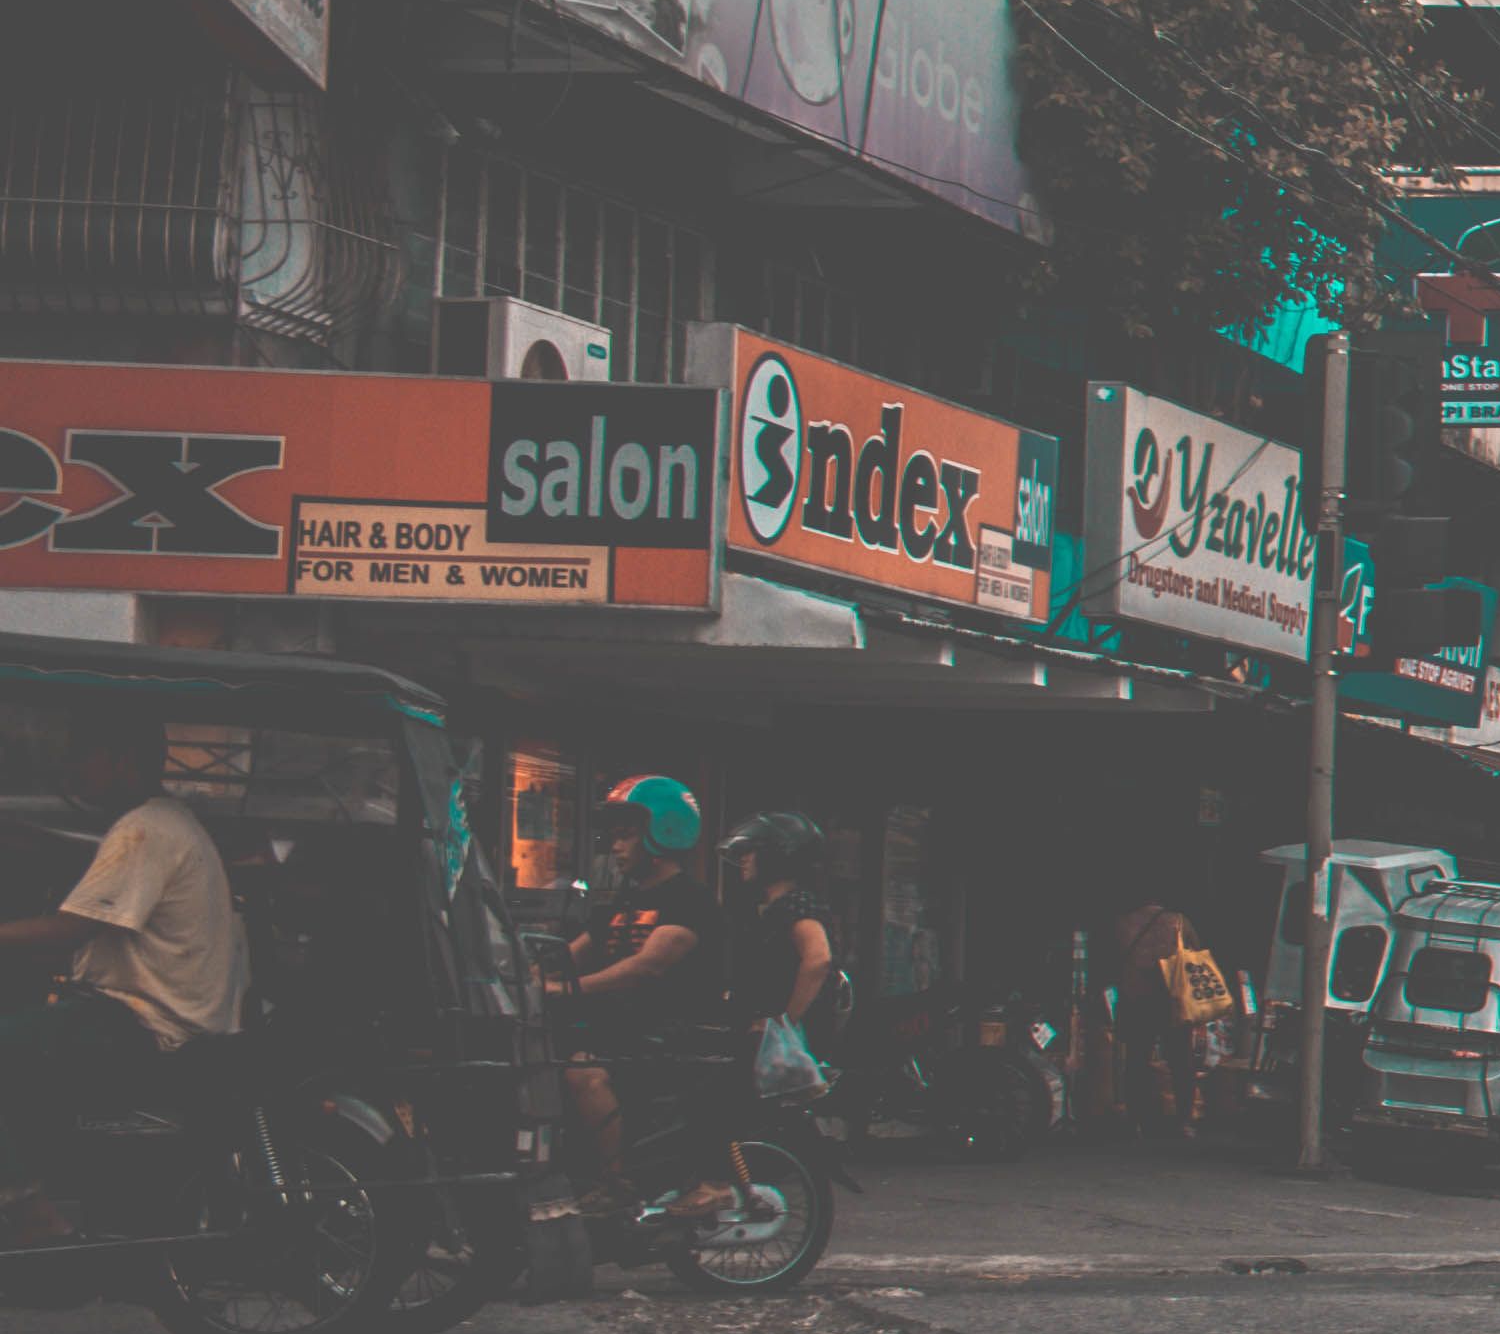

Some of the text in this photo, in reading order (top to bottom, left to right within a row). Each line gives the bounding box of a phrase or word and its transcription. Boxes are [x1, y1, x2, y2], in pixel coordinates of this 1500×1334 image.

[1469, 383, 1498, 392] STOP
[501, 415, 698, 521] salon
[1016, 459, 1052, 547] salon
[1168, 435, 1316, 581] Yzavelle
[299, 519, 470, 552] HAIR & BODY
[297, 560, 588, 589] FOR MEN & WOMEN
[1128, 552, 1193, 599] Drugstore
[1196, 578, 1220, 606] and
[1222, 577, 1266, 620] Medical
[1269, 593, 1308, 637] Supply
[1418, 661, 1441, 683] STOP
[1442, 666, 1477, 693] AGRIVET
